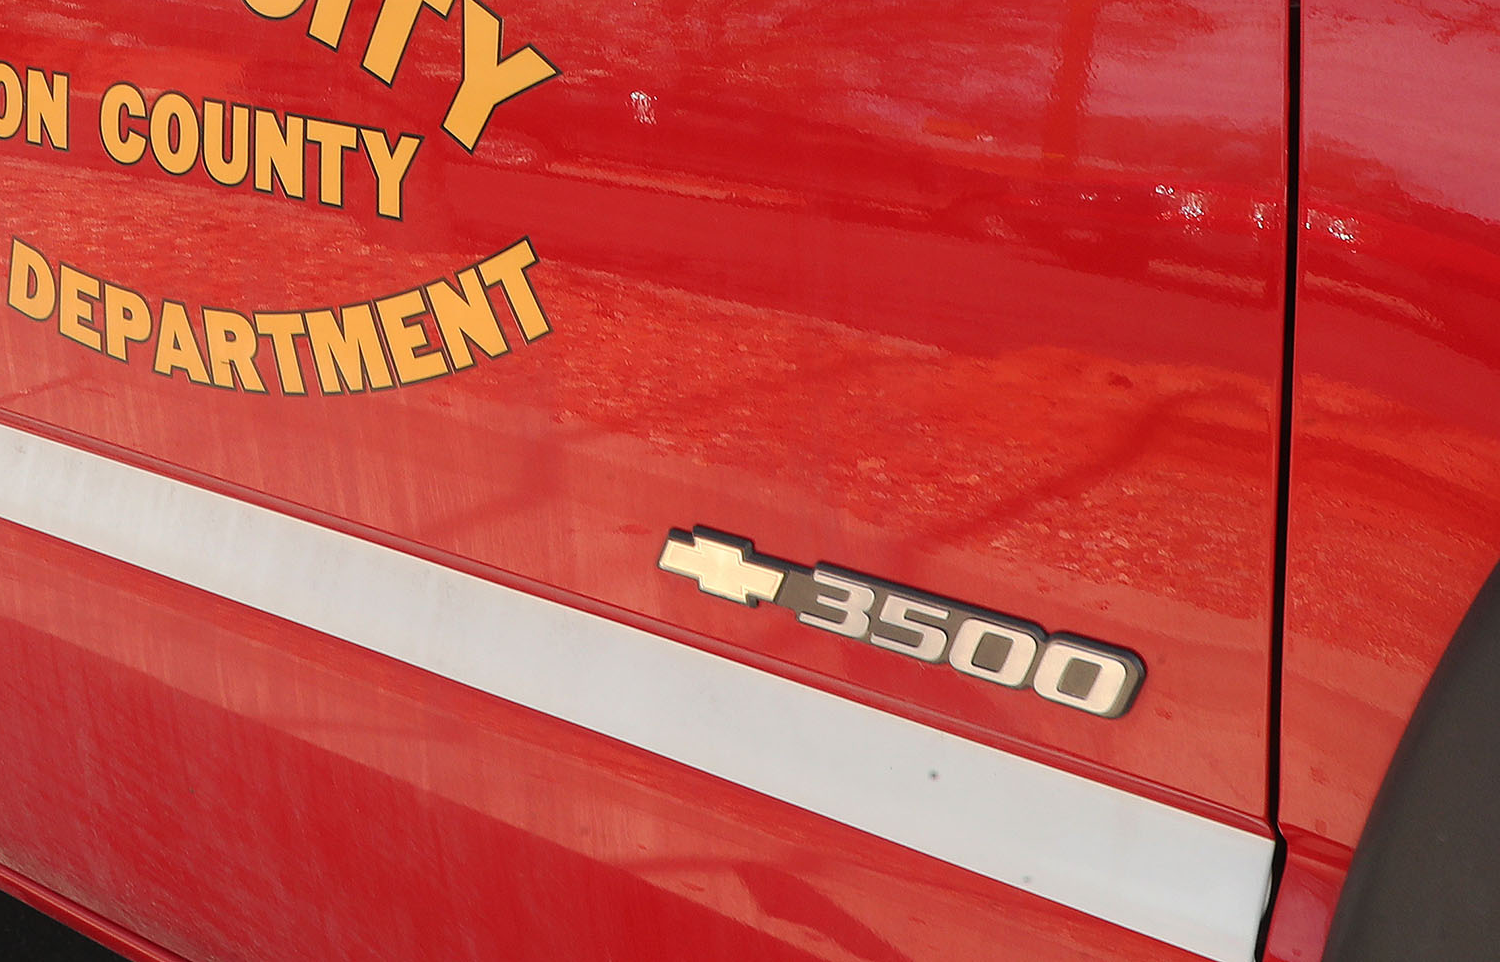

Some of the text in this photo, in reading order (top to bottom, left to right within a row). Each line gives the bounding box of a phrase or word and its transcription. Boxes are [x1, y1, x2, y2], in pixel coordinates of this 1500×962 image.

[100, 82, 424, 221] COUNTY
[7, 236, 551, 396] DEPARTMENT
[799, 567, 1128, 716] 3500
